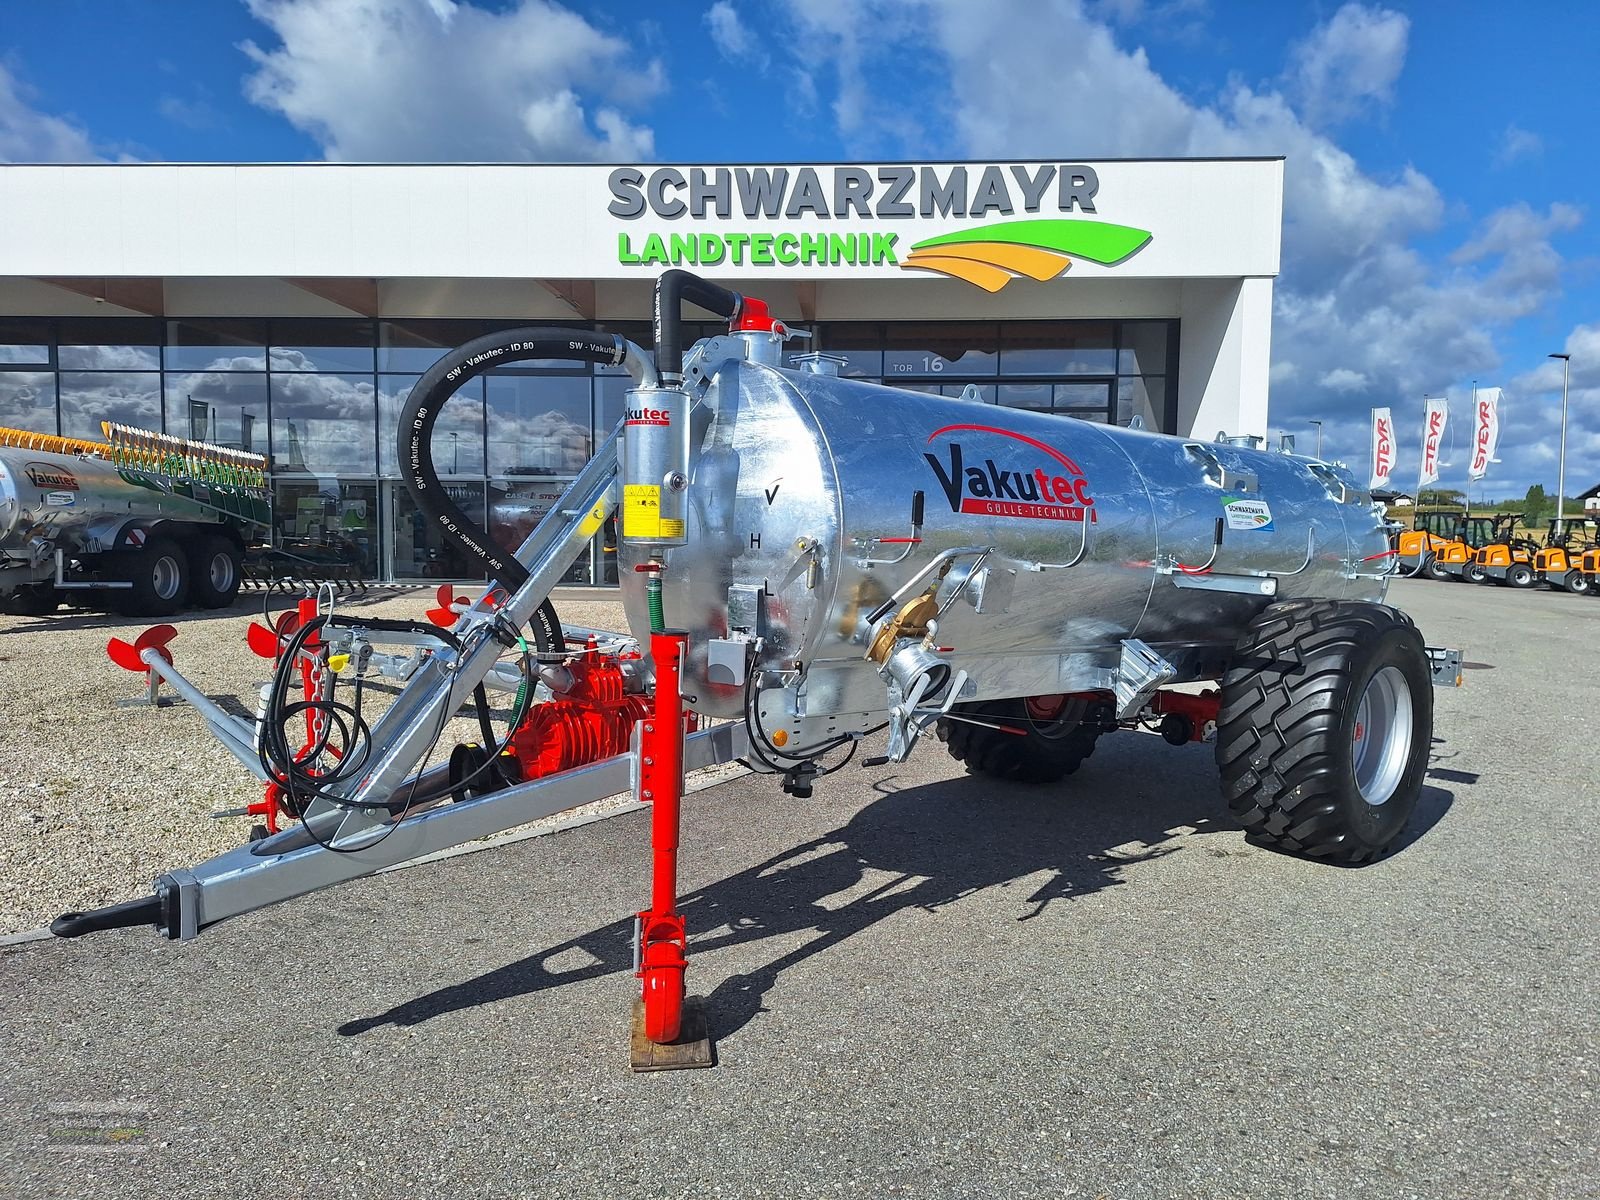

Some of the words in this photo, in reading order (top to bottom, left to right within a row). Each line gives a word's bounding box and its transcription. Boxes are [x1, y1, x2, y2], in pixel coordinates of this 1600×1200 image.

[607, 165, 1099, 219] SCHWARZMAYR
[618, 233, 899, 266] LANDTECHNIK
[569, 341, 583, 350] SW
[590, 344, 616, 355] Vakute
[447, 366, 461, 381] SW
[466, 348, 503, 367] Vakutec
[510, 343, 521, 352] ID
[523, 341, 534, 350] 80
[893, 364, 913, 372] TOR
[922, 356, 944, 372] 16
[417, 407, 428, 419] 80
[413, 419, 423, 429] ID
[1474, 401, 1490, 470] STEYR
[411, 436, 419, 470] Vakutec
[1376, 418, 1390, 477] STEYR
[24, 468, 78, 487] Vakutec
[414, 476, 426, 490] SW
[923, 443, 1095, 512] Vakutec
[765, 485, 780, 505] V
[439, 515, 450, 525] 80
[447, 523, 457, 532] ID
[460, 534, 486, 558] Vakutec
[750, 532, 761, 549] H
[489, 558, 503, 570] SW
[764, 580, 775, 596] L
[537, 609, 552, 637] Vakutec
